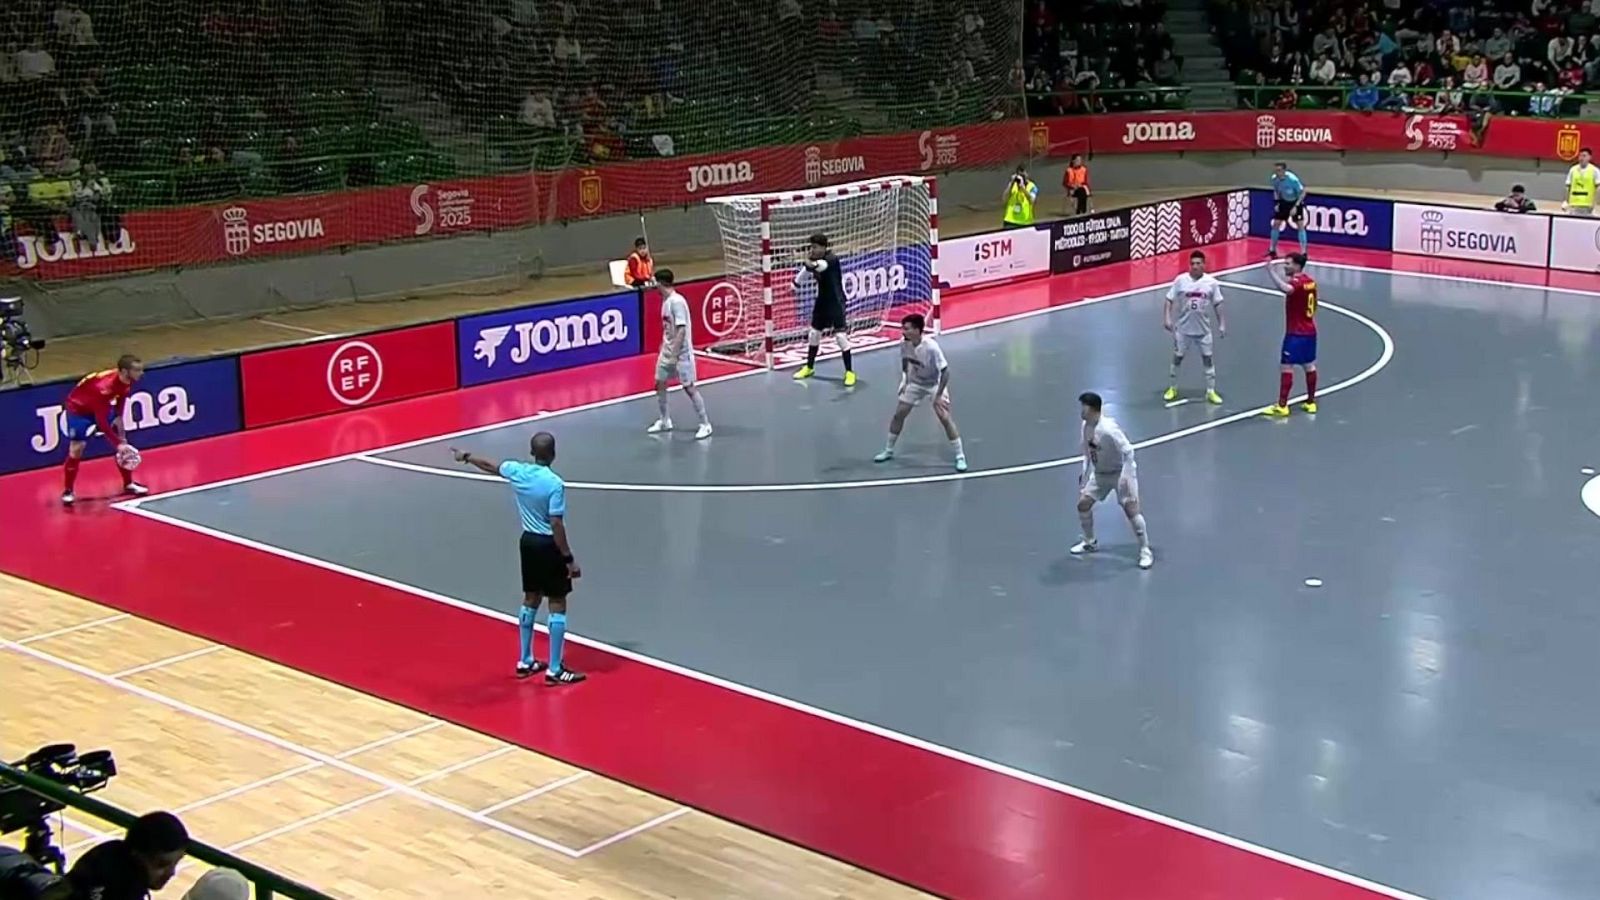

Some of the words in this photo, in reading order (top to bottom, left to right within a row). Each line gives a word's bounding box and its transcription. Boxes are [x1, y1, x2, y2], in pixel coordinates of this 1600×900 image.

[1277, 127, 1333, 143] SEGOVIA
[1428, 138, 1457, 150] 2025
[822, 156, 865, 176] SEGOVIA
[439, 211, 471, 227] 2025
[253, 218, 324, 243] SEGOVIA
[1446, 230, 1517, 254] SEGOVIA
[841, 264, 908, 300] oma
[1191, 300, 1198, 310] 6
[1306, 293, 1315, 318] 9
